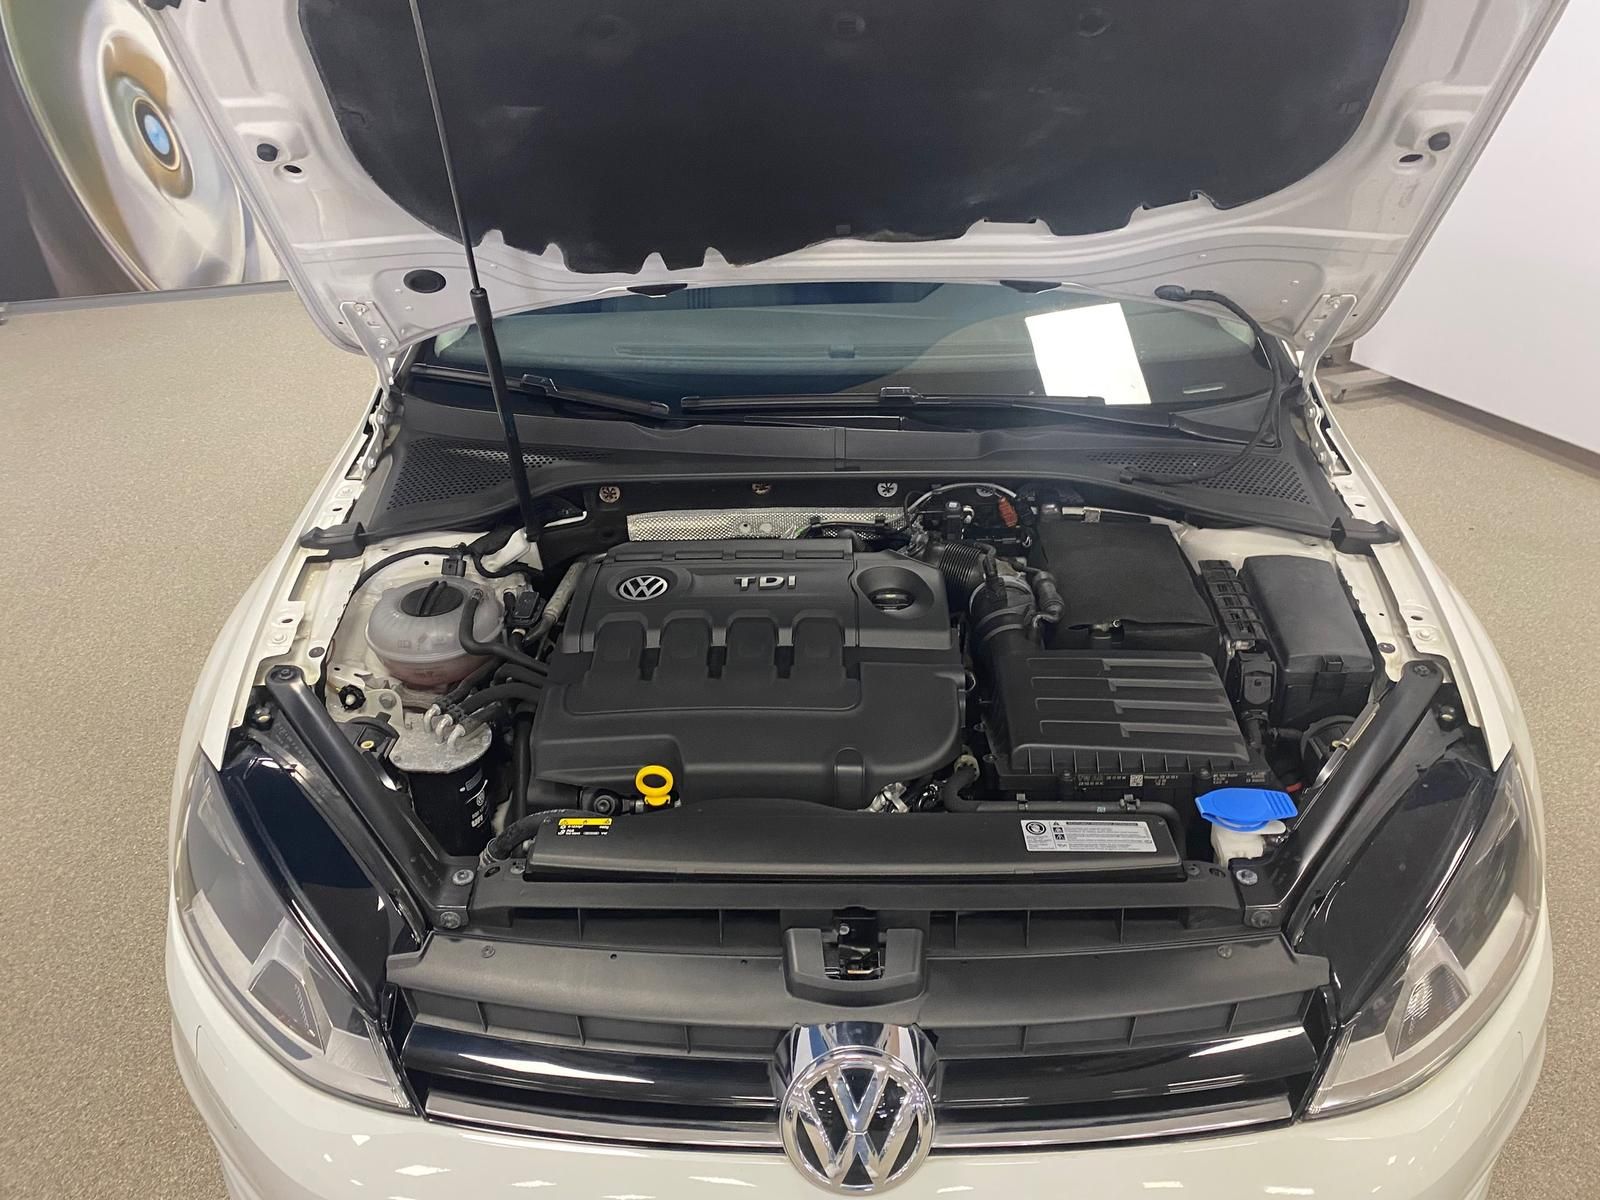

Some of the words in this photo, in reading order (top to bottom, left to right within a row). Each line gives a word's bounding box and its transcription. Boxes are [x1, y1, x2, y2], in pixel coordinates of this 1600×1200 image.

[618, 575, 669, 601] VW
[735, 575, 797, 590] TDI
[779, 1045, 935, 1197] VW
